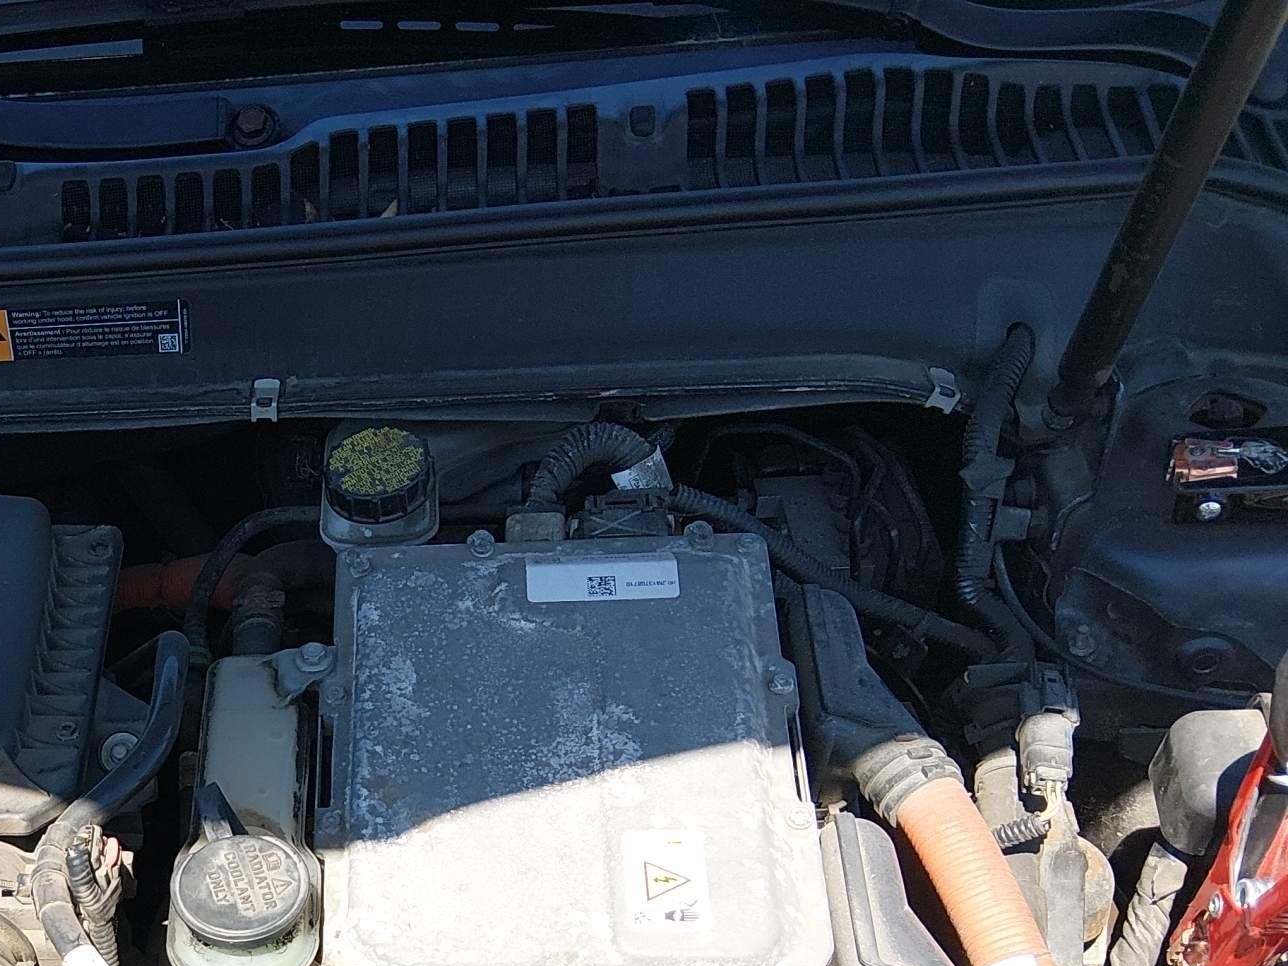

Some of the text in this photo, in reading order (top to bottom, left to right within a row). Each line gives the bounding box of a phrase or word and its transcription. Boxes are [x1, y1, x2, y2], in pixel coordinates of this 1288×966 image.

[208, 867, 230, 904] ONLY
[223, 850, 256, 913] COOLANT
[241, 841, 278, 912] RADIATOR
